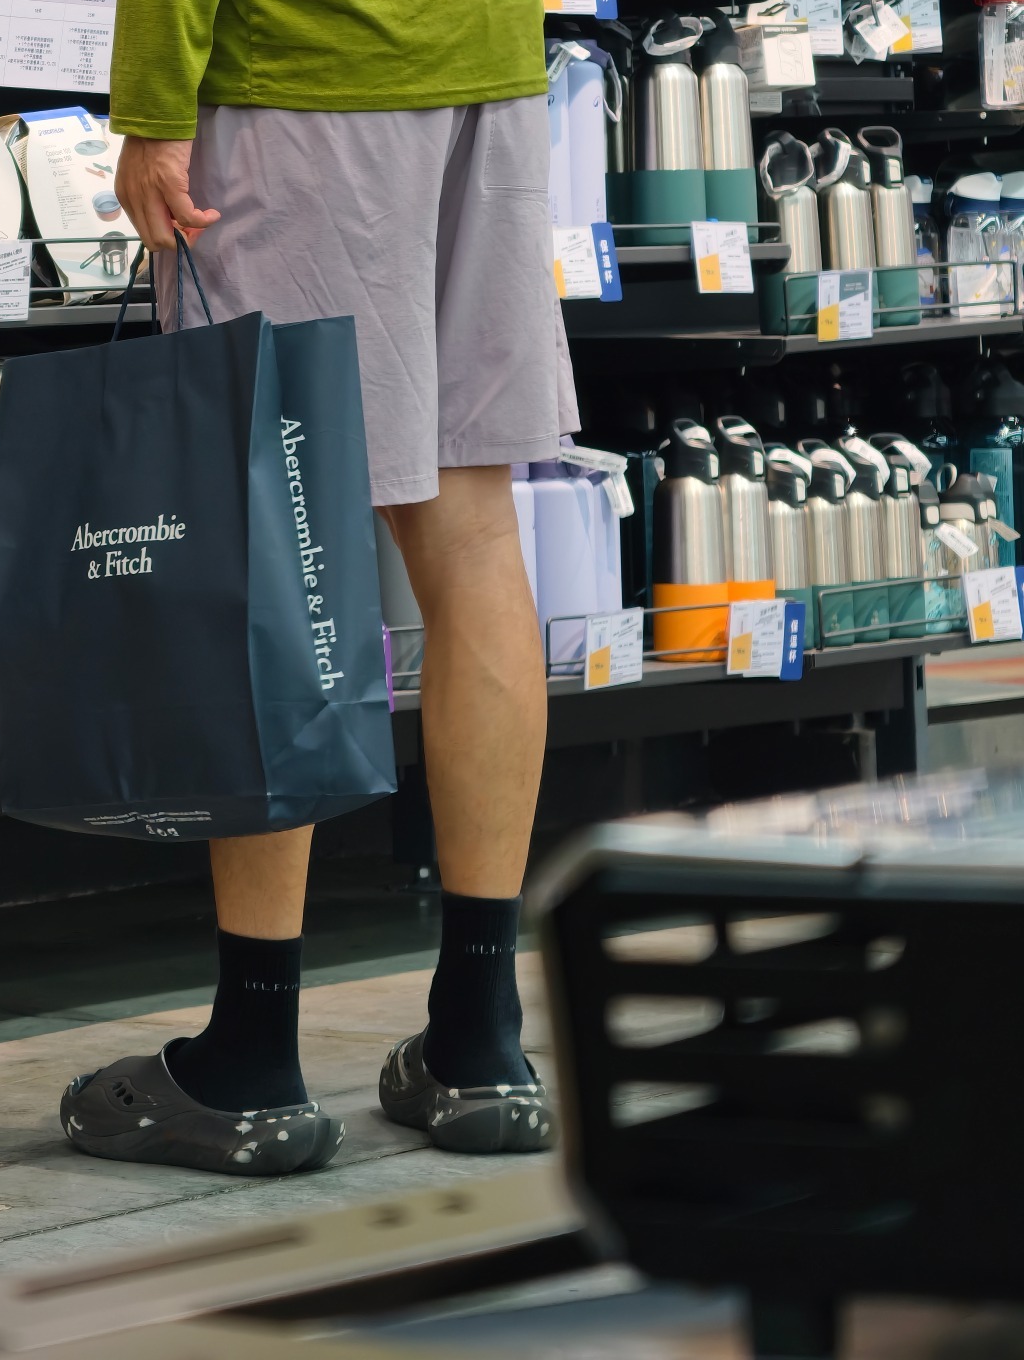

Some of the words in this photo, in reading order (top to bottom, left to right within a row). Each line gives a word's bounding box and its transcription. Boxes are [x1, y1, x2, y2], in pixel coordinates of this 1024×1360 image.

[280, 414, 324, 589] Abercrombie
[71, 513, 187, 552] Abercrombie
[87, 560, 101, 579] &
[104, 547, 153, 578] Fitch
[307, 593, 325, 615] &
[310, 617, 346, 692] Fitch
